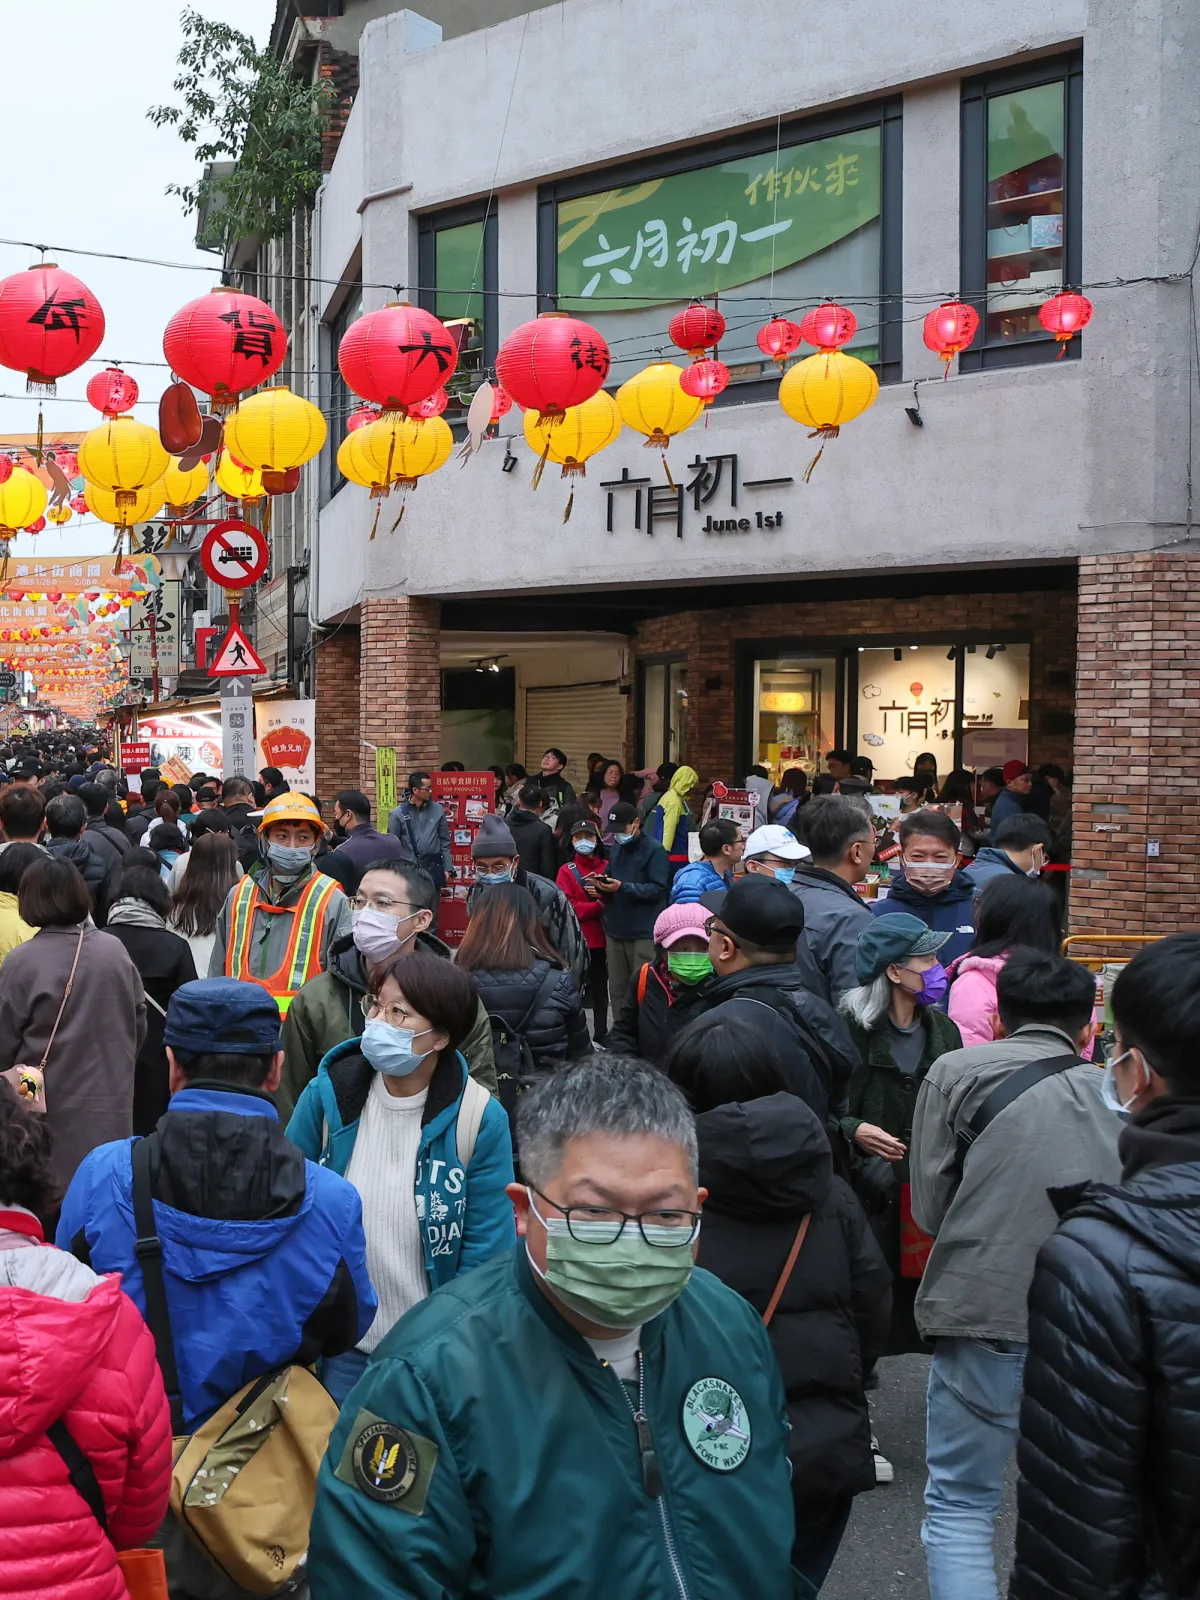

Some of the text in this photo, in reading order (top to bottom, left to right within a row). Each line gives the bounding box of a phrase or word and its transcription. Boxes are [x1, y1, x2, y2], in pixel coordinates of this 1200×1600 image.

[581, 211, 793, 297] 六月初一
[27, 286, 90, 345] 年
[218, 308, 277, 368] 貨
[397, 330, 453, 374] 大
[600, 453, 794, 540] 六月初一
[702, 511, 784, 533] June 1st
[15, 563, 102, 577] 迪化街商圈
[696, 1443, 748, 1467] FORT WAYNE
